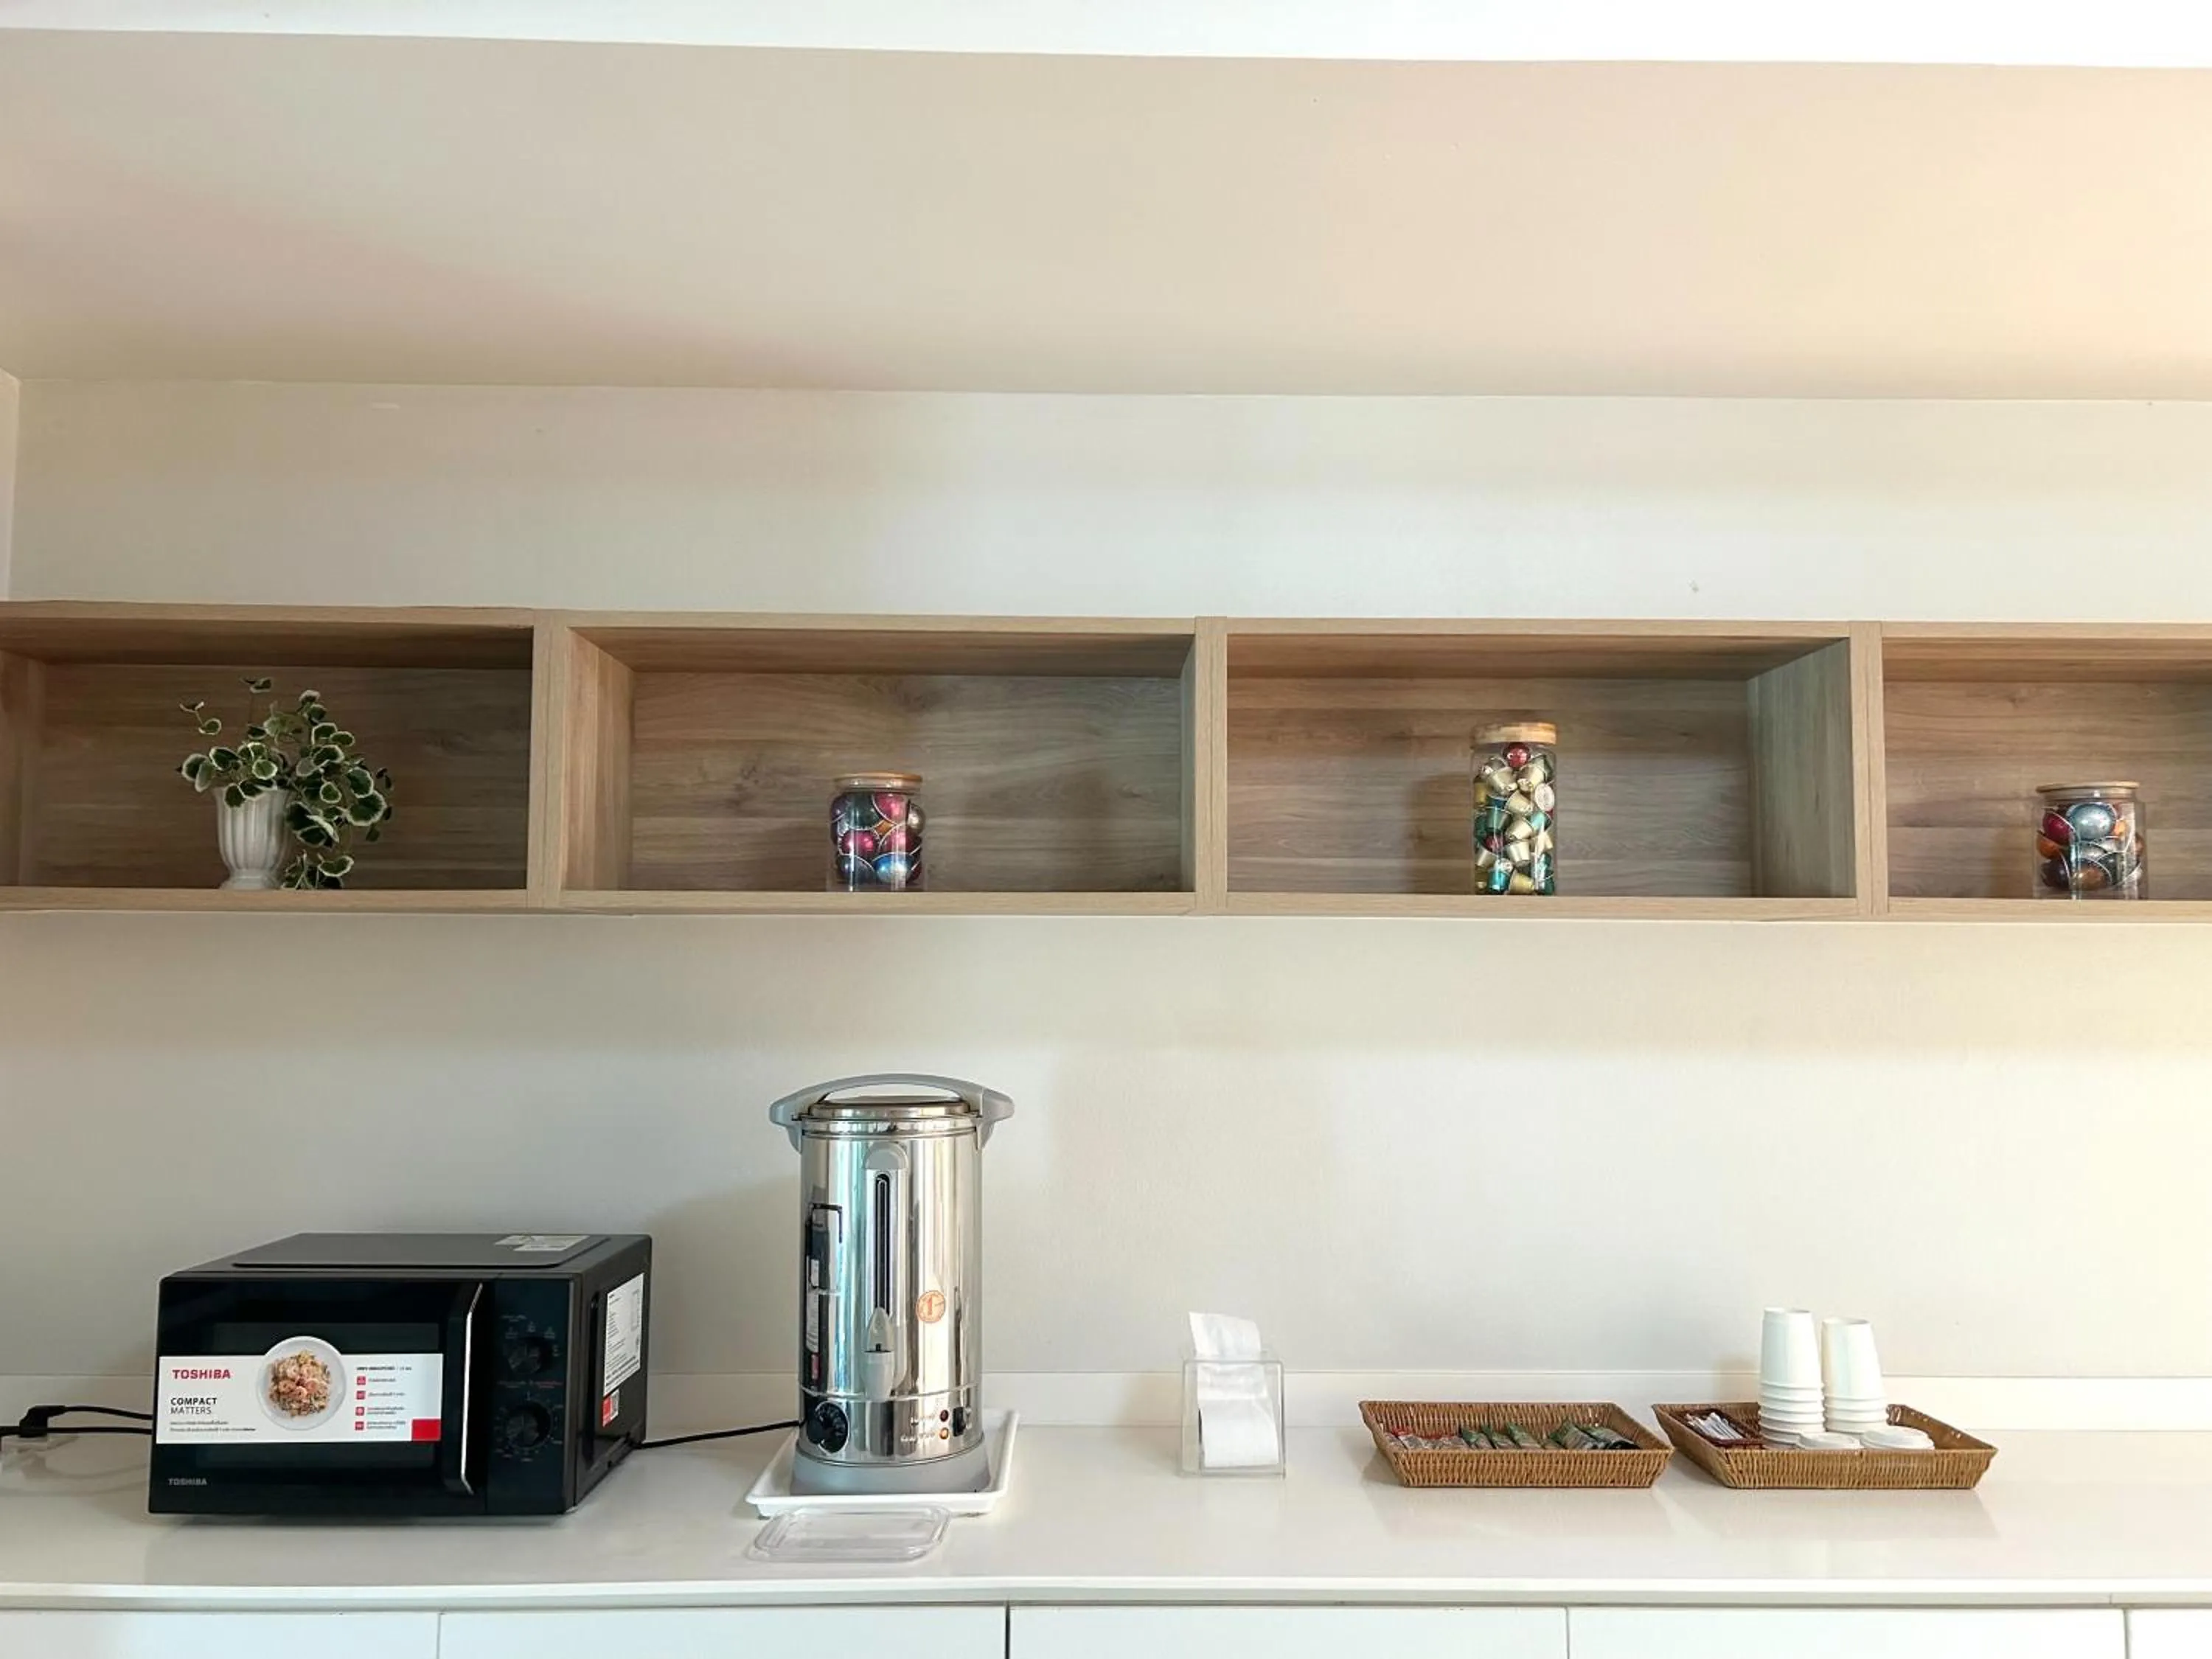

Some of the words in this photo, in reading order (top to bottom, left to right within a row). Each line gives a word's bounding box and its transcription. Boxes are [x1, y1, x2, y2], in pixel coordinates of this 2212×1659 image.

[172, 1369, 232, 1380] TOSHIBA
[170, 1397, 218, 1406] COMPACT
[170, 1406, 212, 1415] MATTERS
